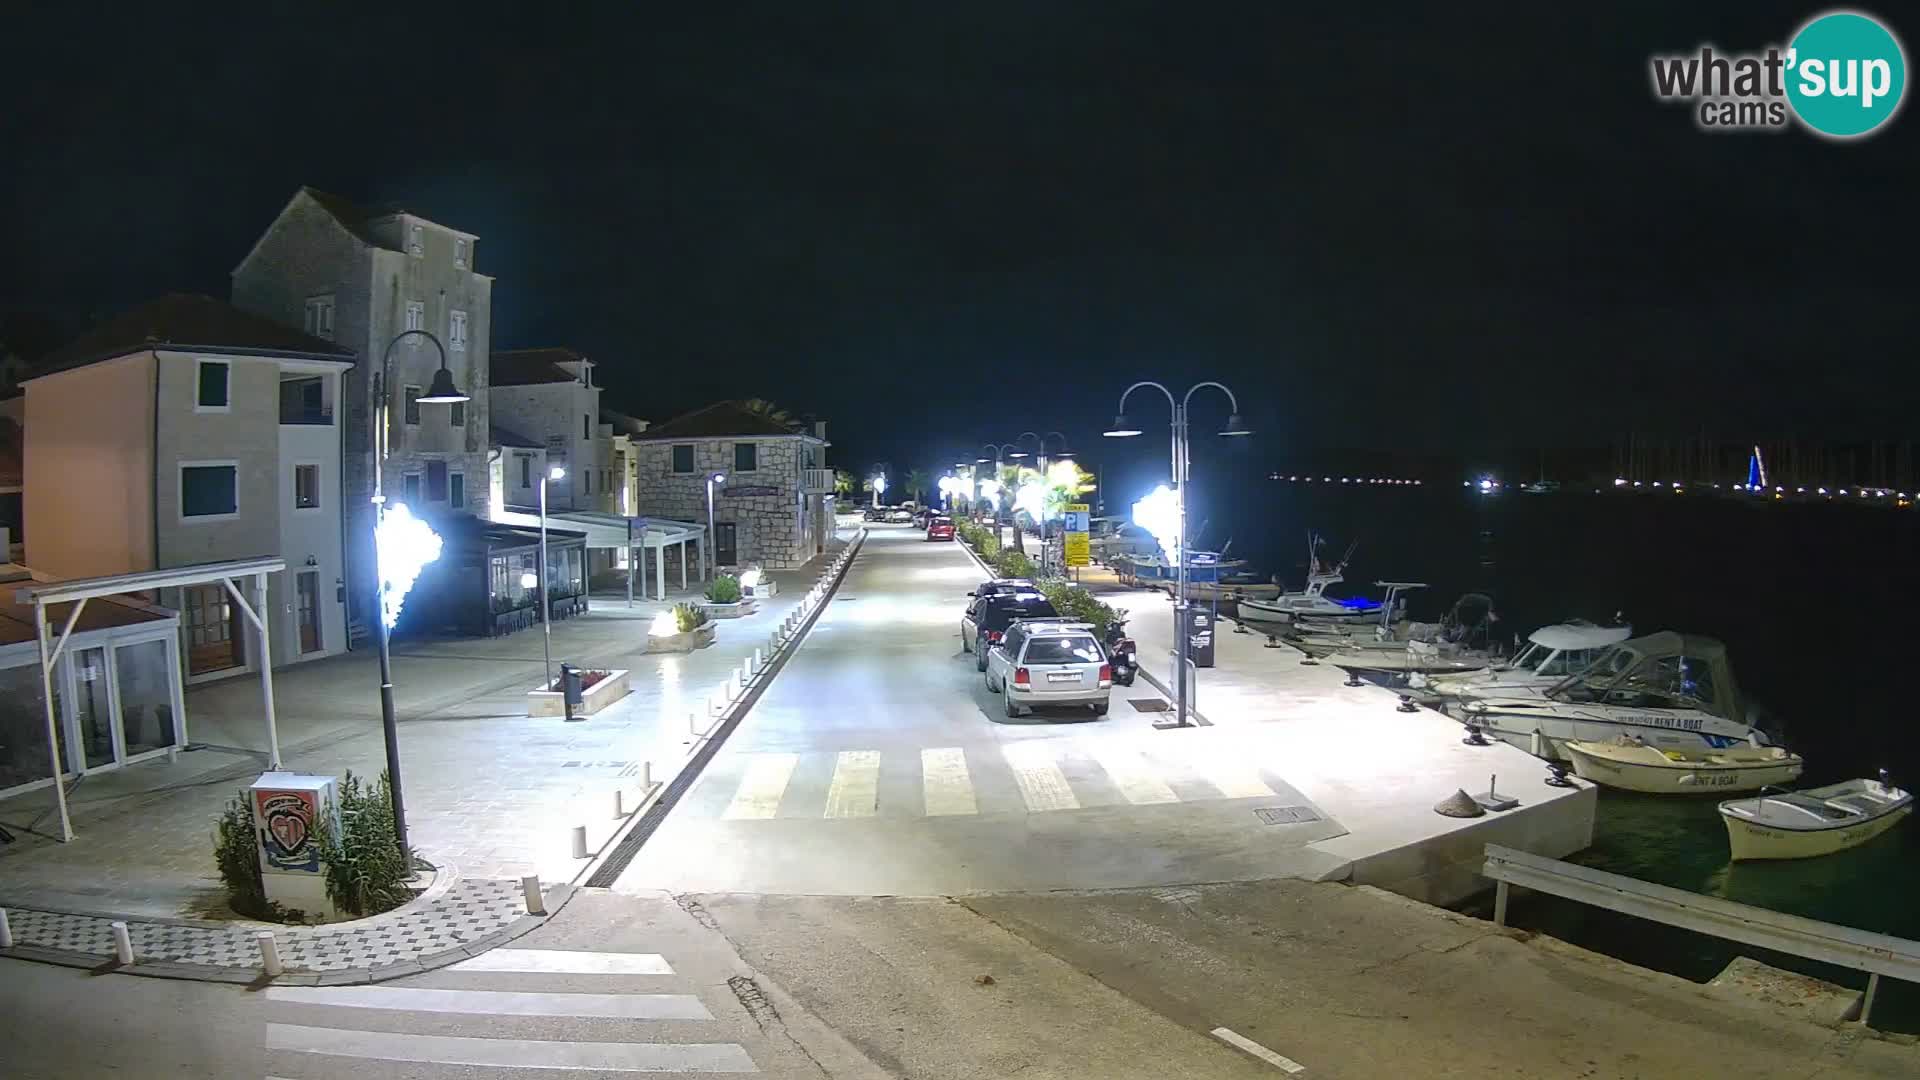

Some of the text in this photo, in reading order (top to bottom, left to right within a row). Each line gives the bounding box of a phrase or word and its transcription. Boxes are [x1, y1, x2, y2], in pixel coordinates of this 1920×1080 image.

[1654, 717, 1675, 727] RENT
[1683, 719, 1704, 730] BOAT
[1719, 775, 1739, 786] BOAT
